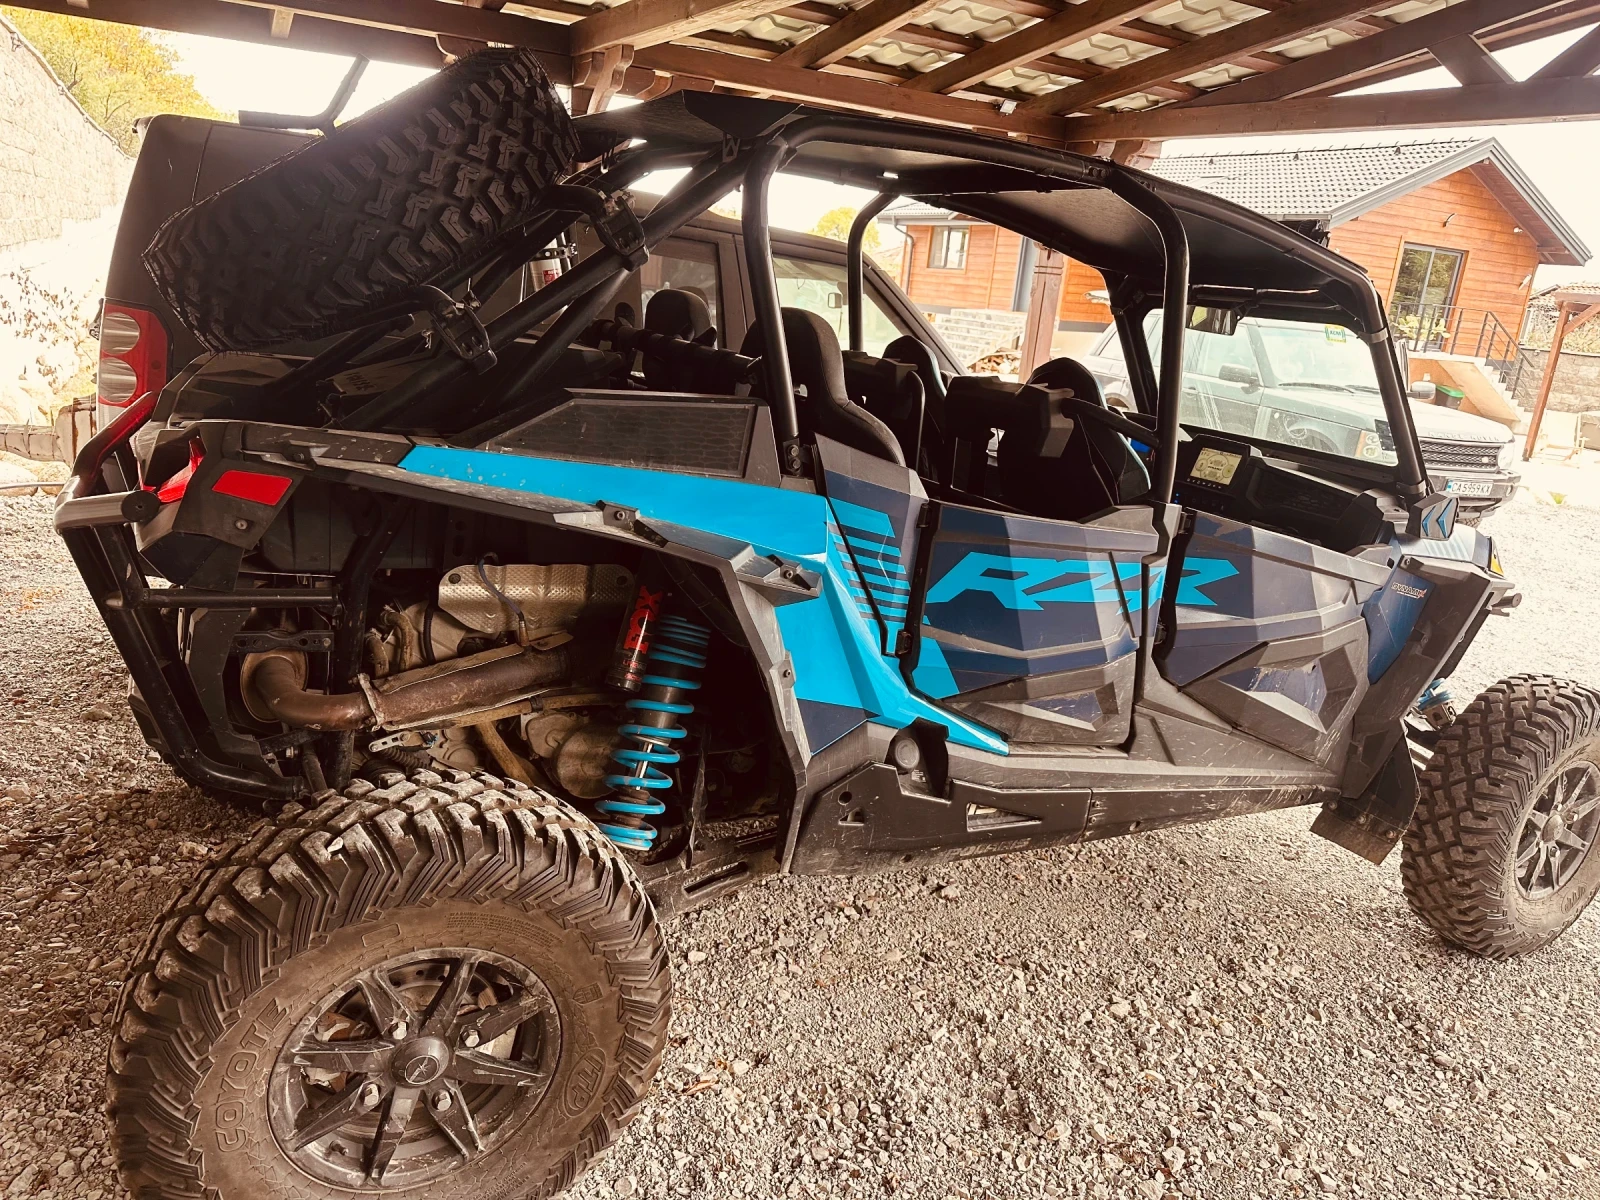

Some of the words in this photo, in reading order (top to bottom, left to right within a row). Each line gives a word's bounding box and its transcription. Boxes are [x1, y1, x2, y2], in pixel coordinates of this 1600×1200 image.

[926, 551, 1240, 616] RZR
[623, 585, 664, 655] FOX
[215, 998, 289, 1152] COYOTE
